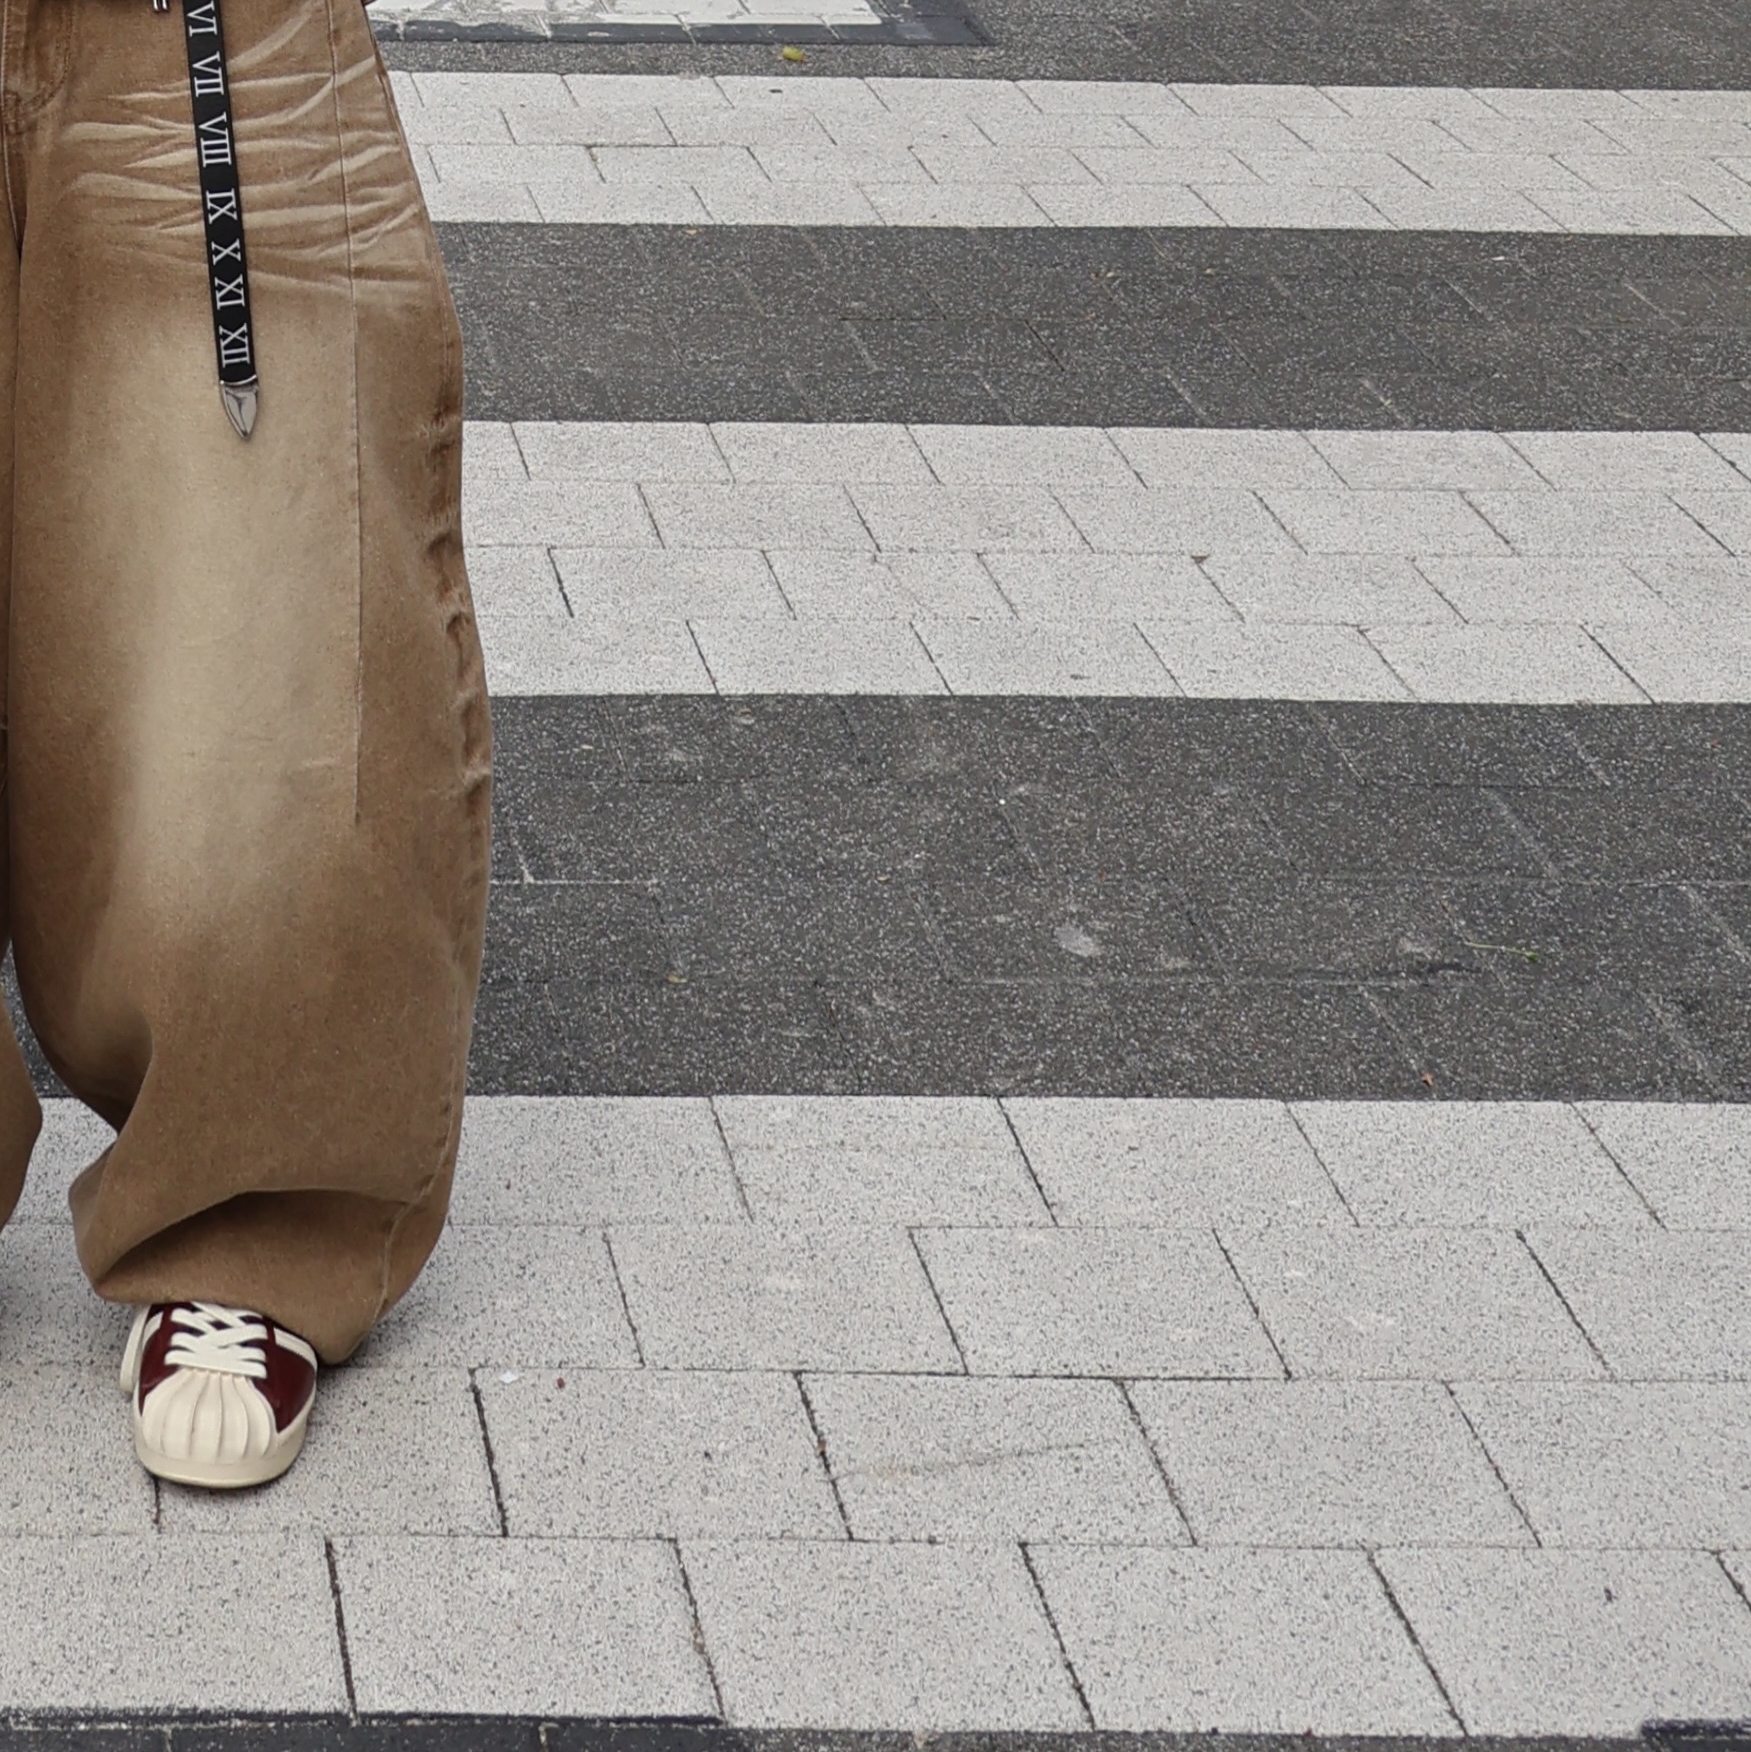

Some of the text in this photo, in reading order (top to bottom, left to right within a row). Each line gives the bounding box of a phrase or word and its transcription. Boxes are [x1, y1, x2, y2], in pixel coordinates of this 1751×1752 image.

[186, 0, 251, 368] VI VII VIII IX X XI XII
